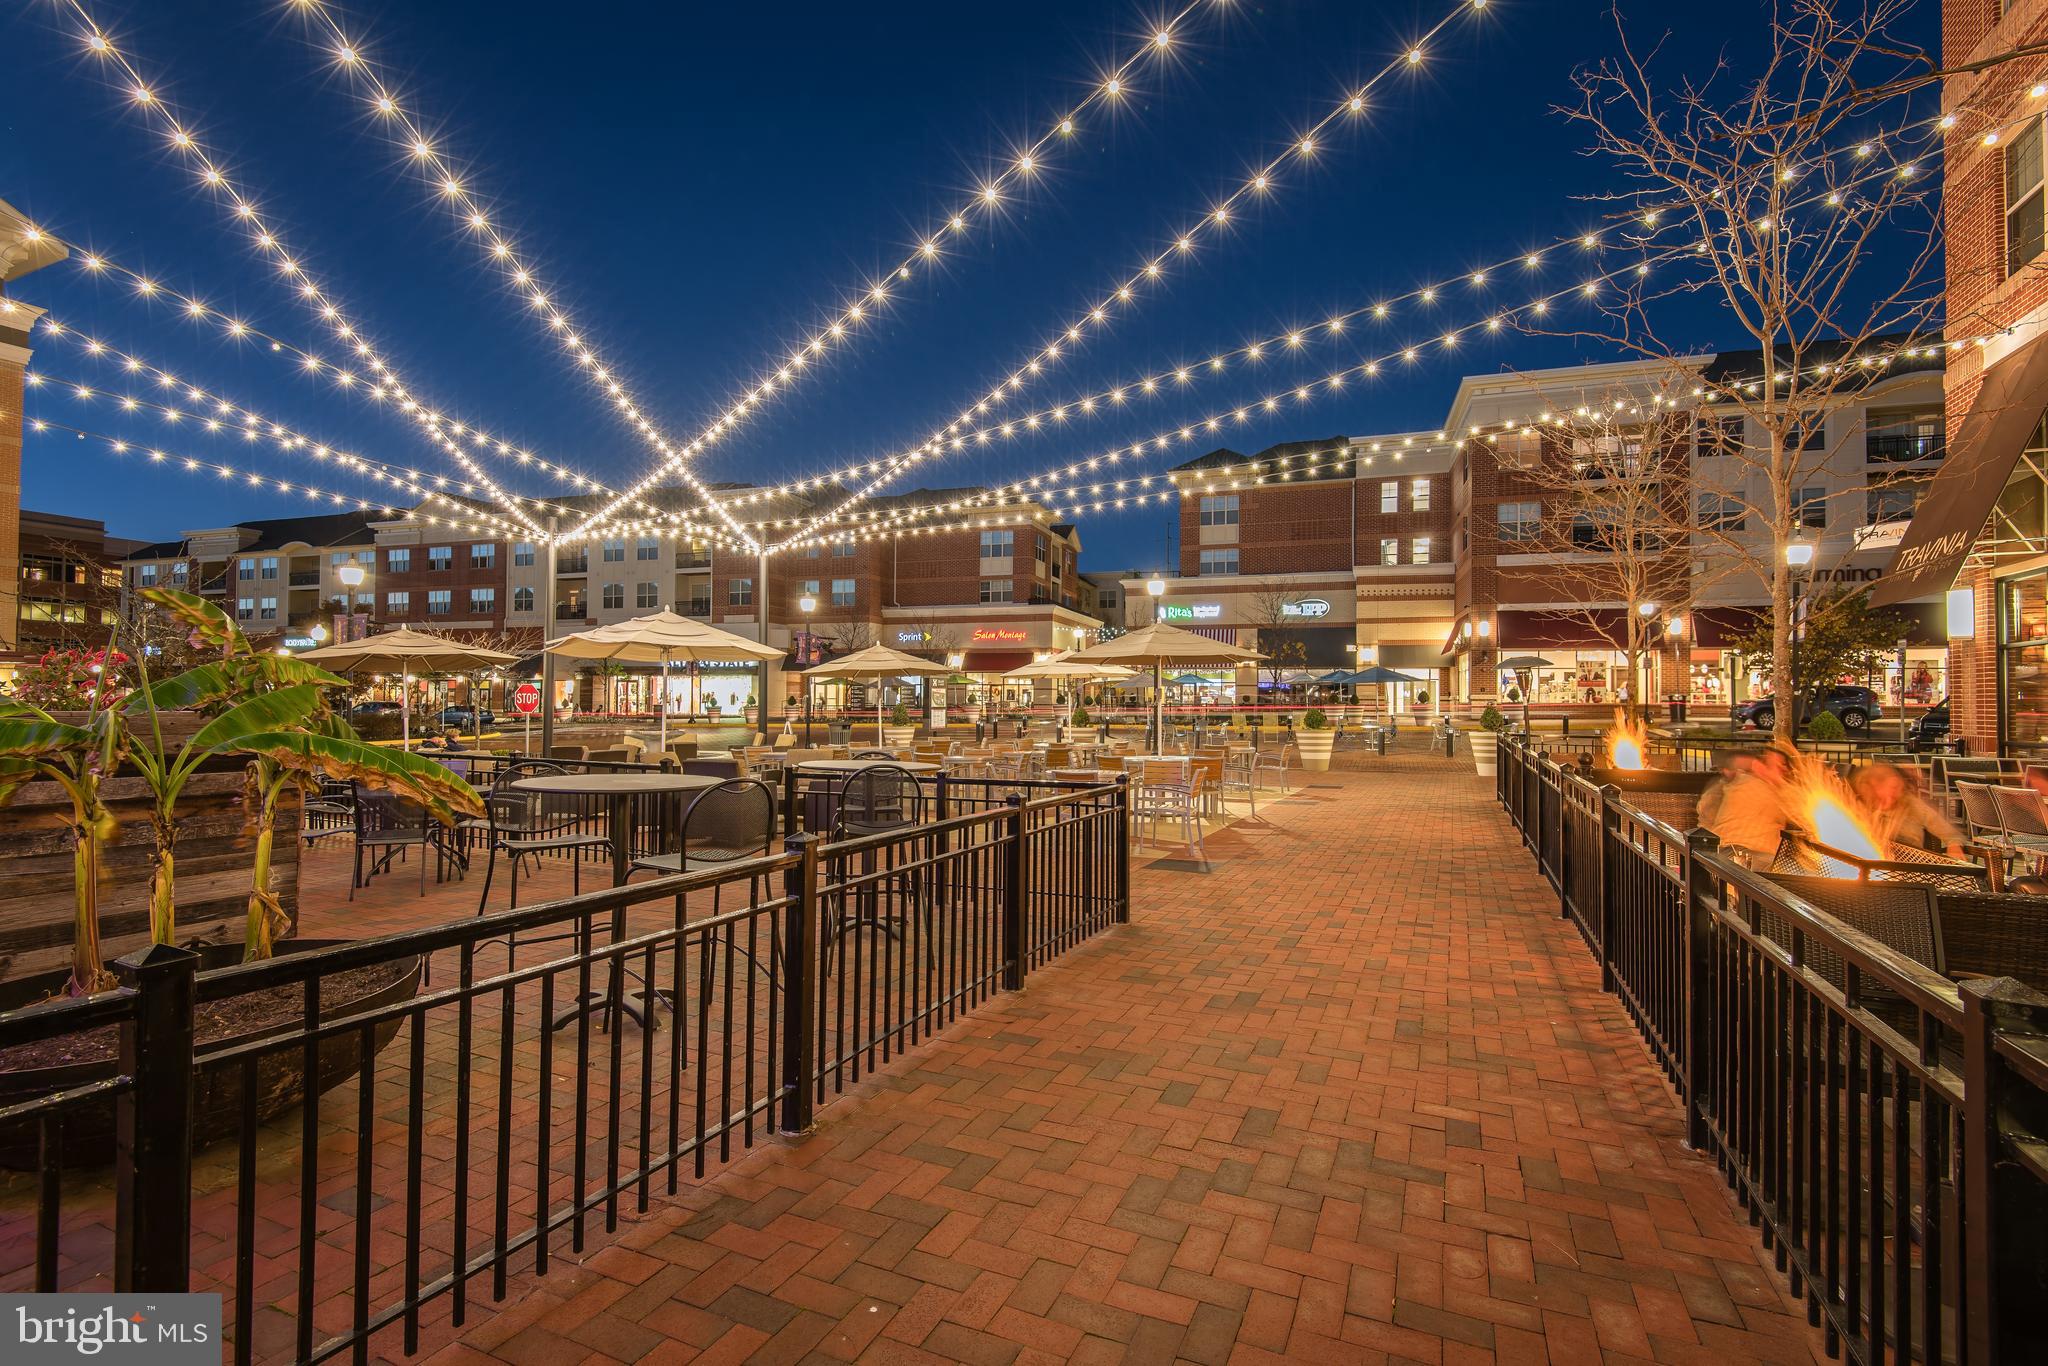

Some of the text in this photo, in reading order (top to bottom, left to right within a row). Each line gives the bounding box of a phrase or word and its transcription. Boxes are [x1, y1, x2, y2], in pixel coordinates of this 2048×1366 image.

[1896, 530, 1968, 571] TRAVINIA
[1168, 606, 1192, 618] Rita's
[899, 632, 922, 642] Sprint
[973, 630, 995, 640] Salon
[516, 692, 538, 704] STOP
